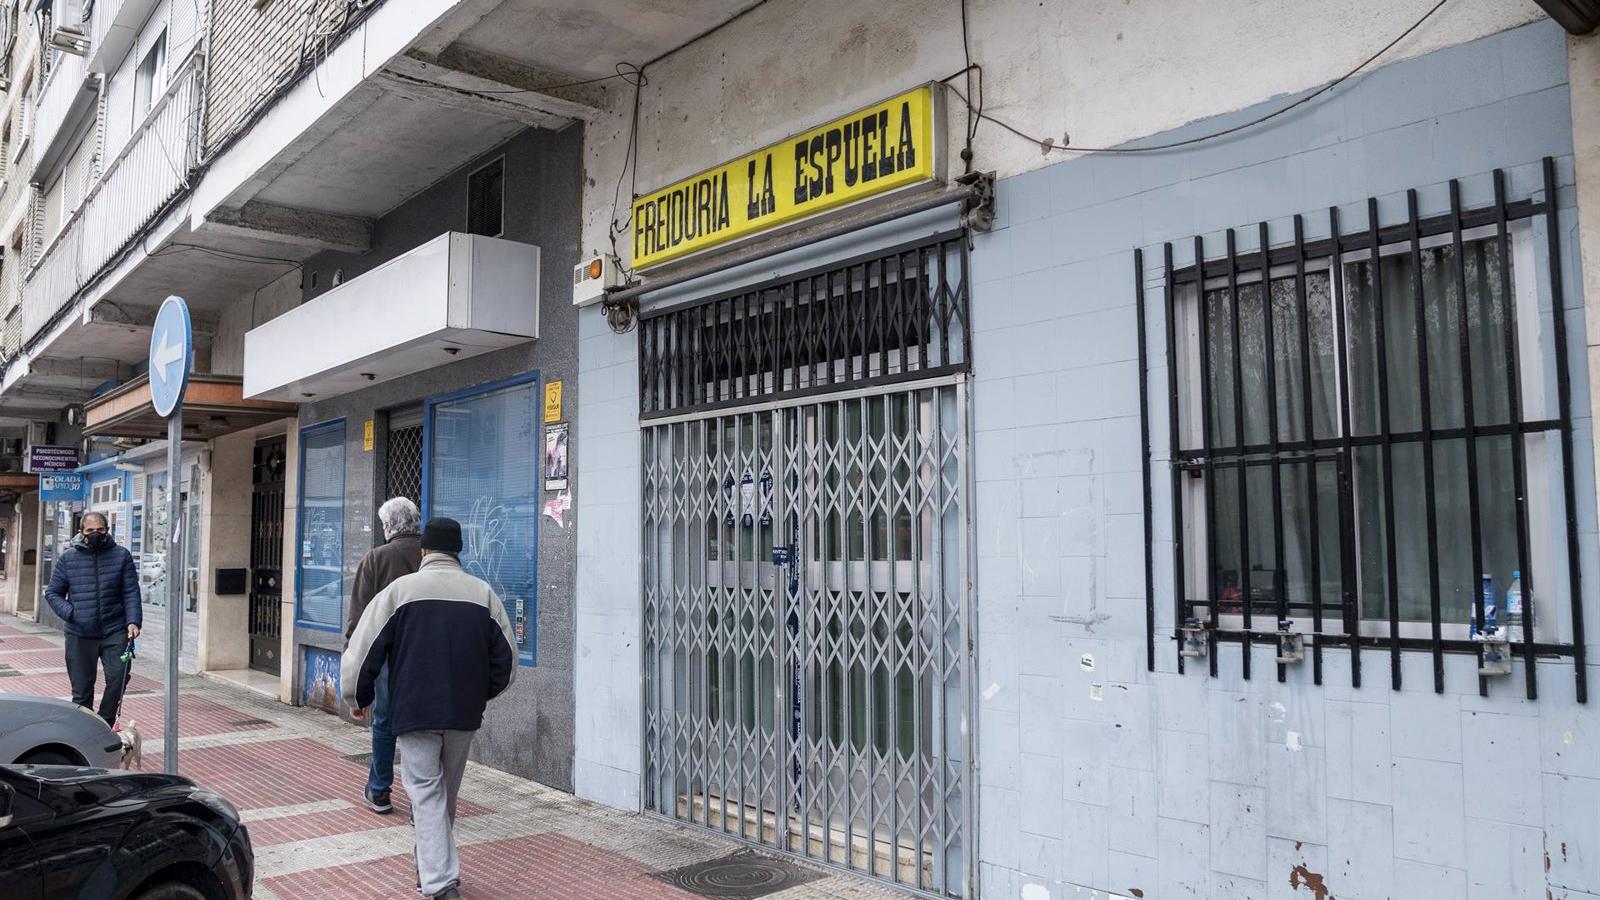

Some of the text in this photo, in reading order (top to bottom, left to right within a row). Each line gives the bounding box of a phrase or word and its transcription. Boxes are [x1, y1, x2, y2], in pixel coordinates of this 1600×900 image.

[634, 101, 916, 259] FREIDURIA LA ESPUELA
